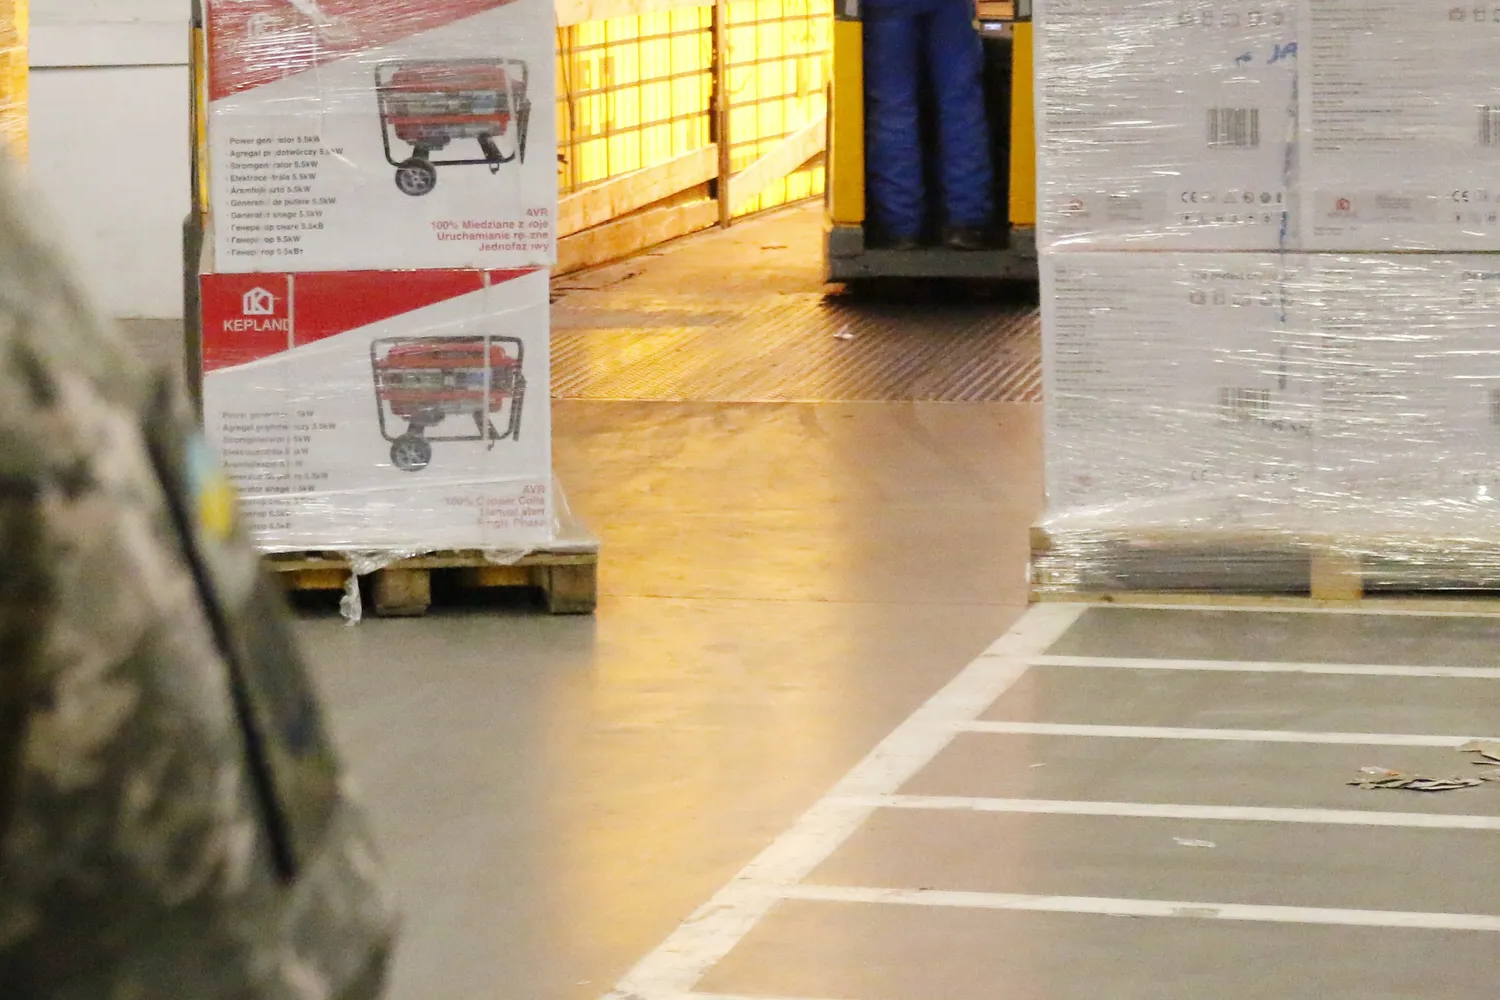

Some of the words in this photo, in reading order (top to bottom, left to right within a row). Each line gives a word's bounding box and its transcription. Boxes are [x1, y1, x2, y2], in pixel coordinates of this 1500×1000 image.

[263, 148, 317, 157] prdotwórczy
[231, 161, 291, 170] Stromgenrator
[231, 173, 289, 182] Elektrocetrala
[231, 211, 270, 219] Generatr
[526, 208, 548, 216] AVR
[462, 219, 515, 229] Miedziane
[518, 219, 549, 229] zoje
[437, 232, 510, 241] Uruchamianie
[513, 232, 549, 241] ręzne
